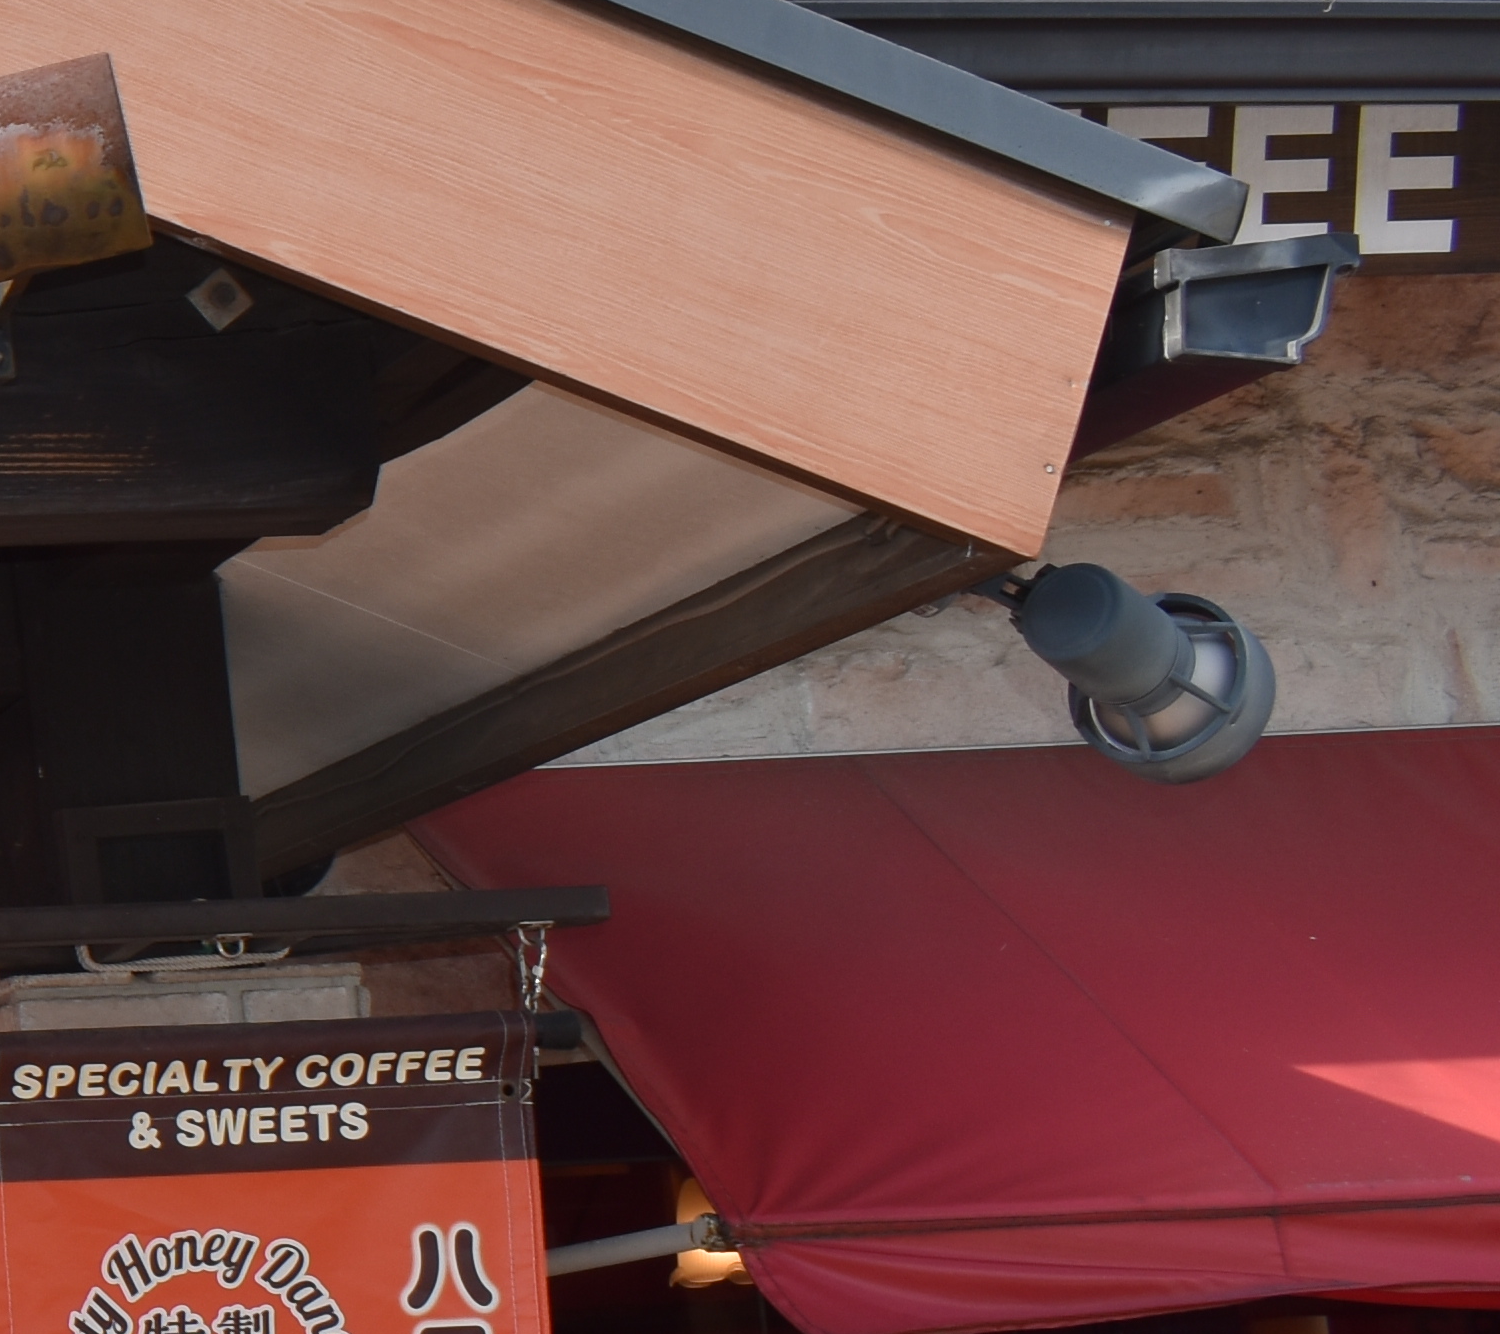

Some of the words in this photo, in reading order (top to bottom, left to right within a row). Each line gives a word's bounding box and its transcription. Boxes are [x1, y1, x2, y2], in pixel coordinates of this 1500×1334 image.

[12, 1056, 284, 1100] SPECIALTY
[295, 1046, 486, 1088] COFFEE
[128, 1111, 161, 1149] &
[175, 1103, 369, 1147] SWEETS
[101, 1228, 259, 1303] Honey
